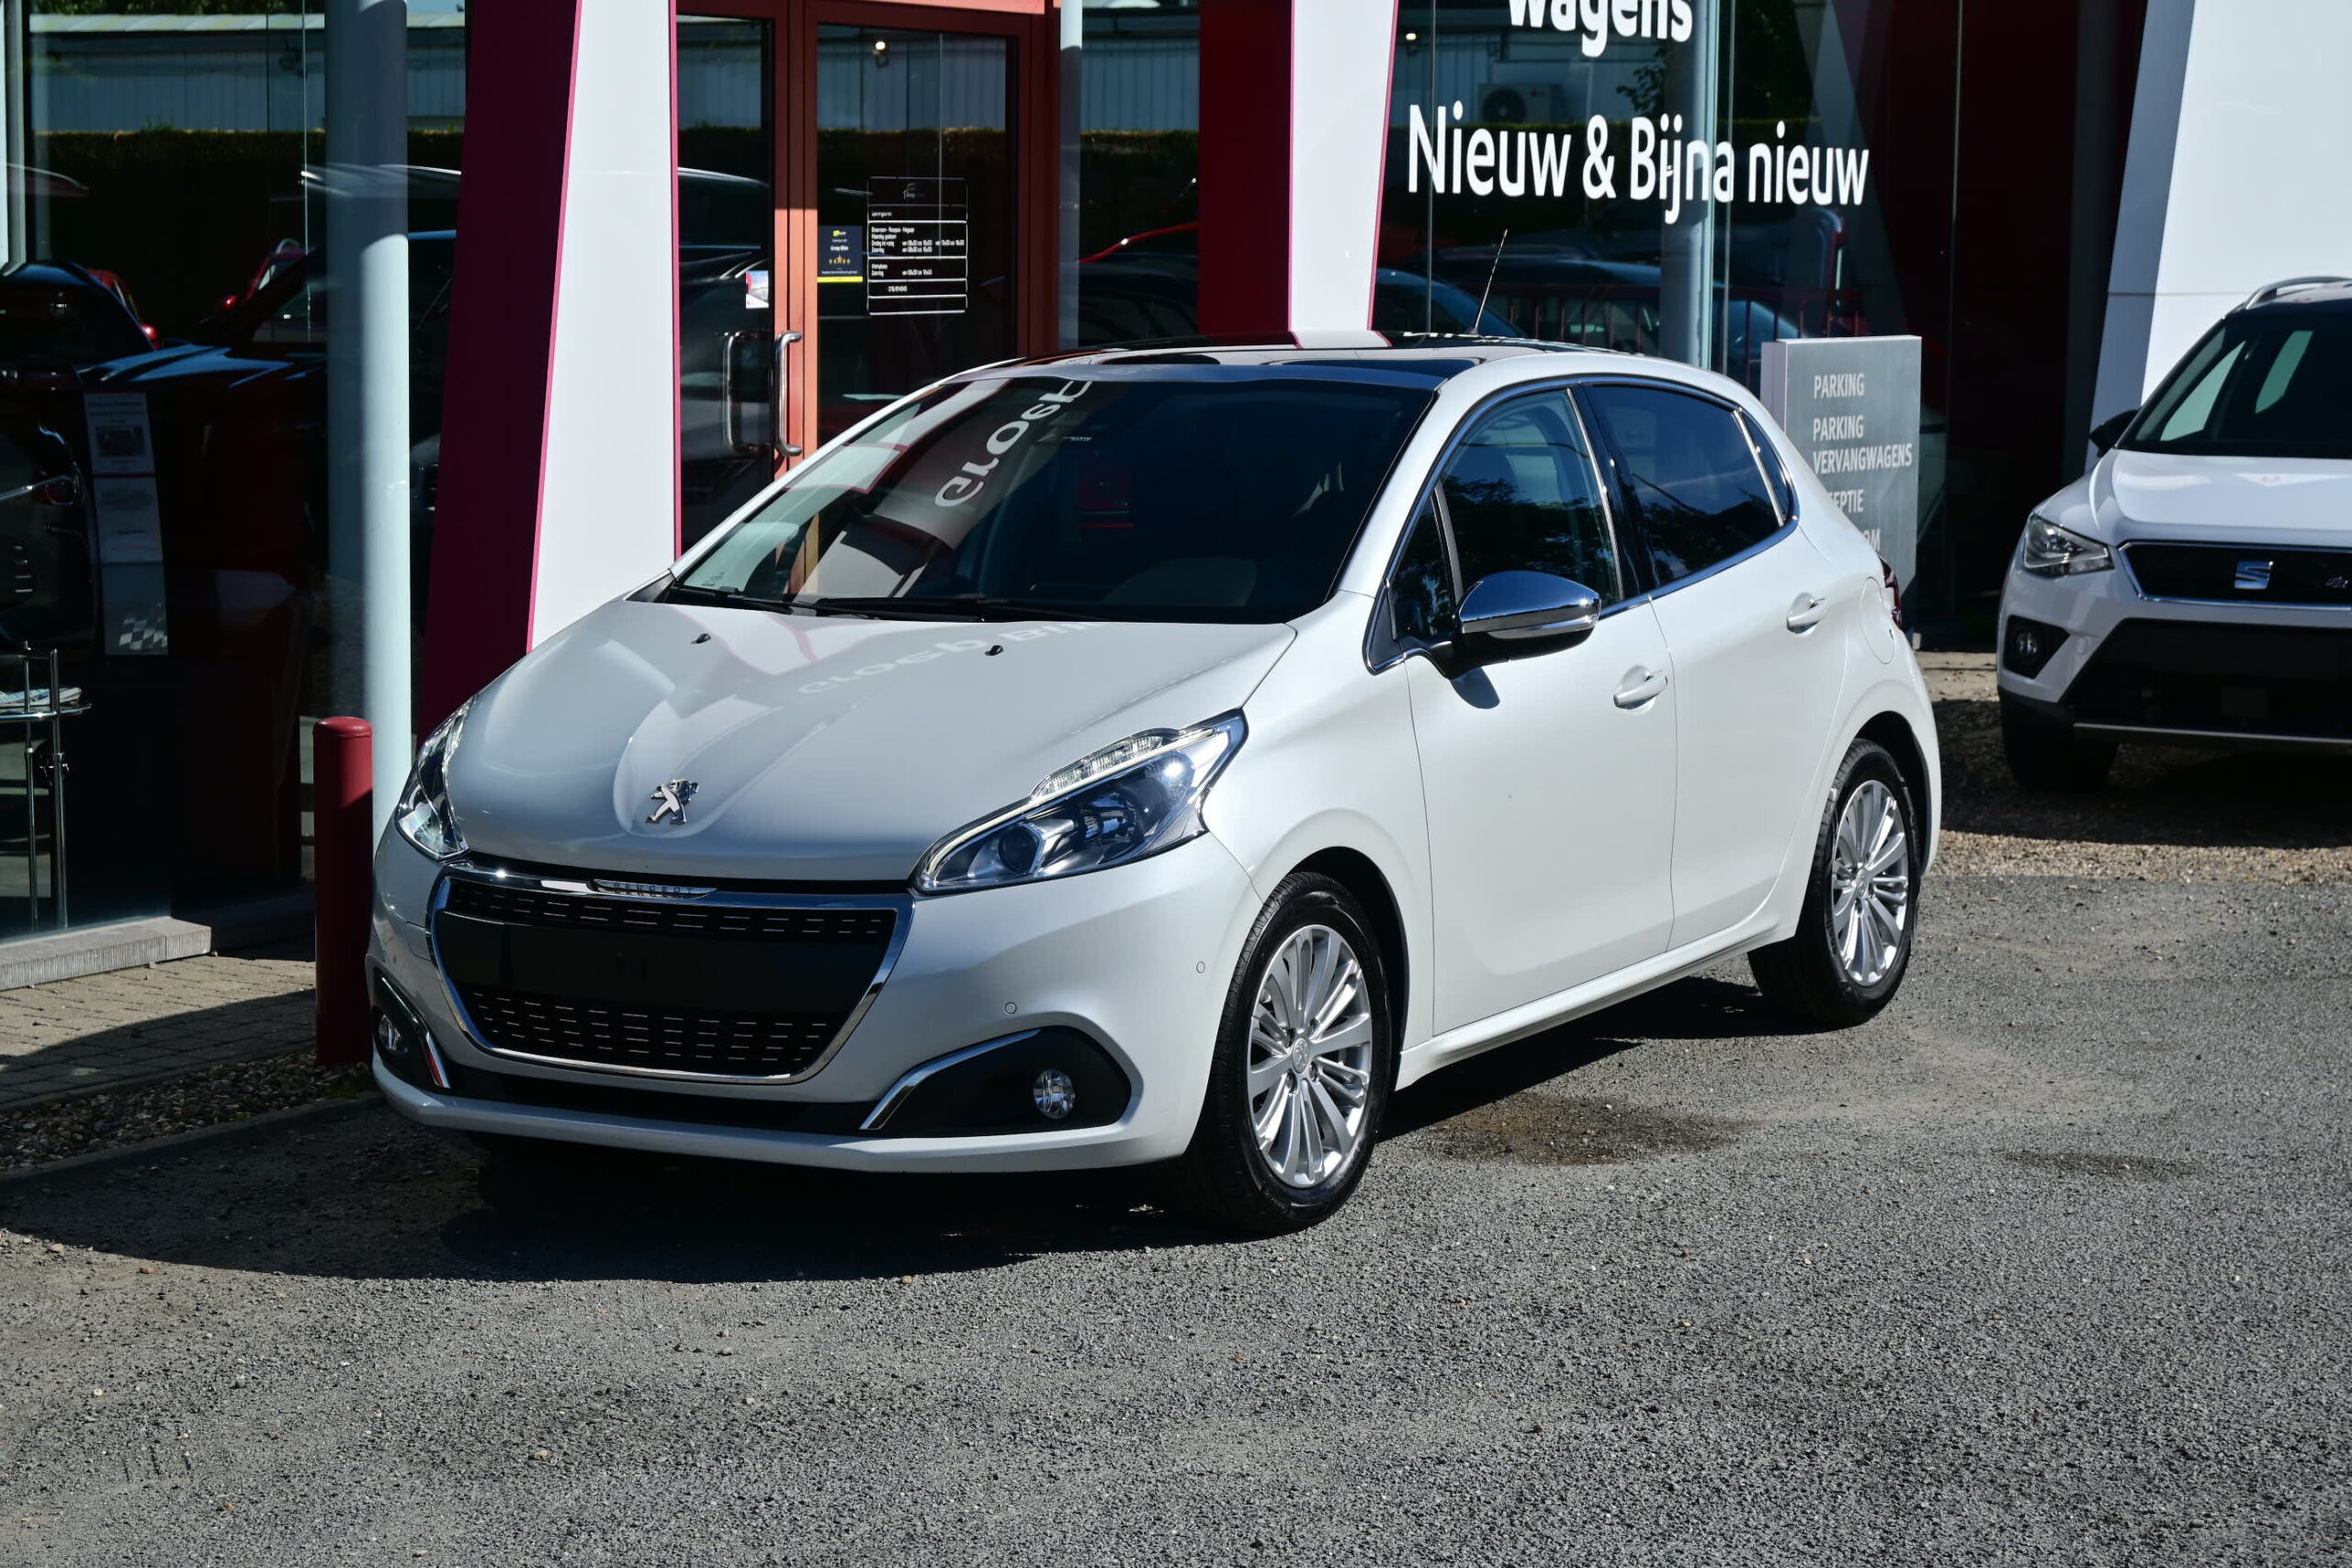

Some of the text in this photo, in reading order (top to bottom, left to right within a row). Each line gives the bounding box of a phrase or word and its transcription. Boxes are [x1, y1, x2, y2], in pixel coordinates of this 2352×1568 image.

[1408, 101, 1869, 225] Nieuw & Bijna nieuw
[1814, 373, 1865, 399] PARKING
[1813, 415, 1864, 441] PARKING
[1813, 443, 1913, 475] VERVANGWAGENS
[1827, 489, 1864, 513] EPTIE
[613, 882, 694, 894] PEUGEOT
